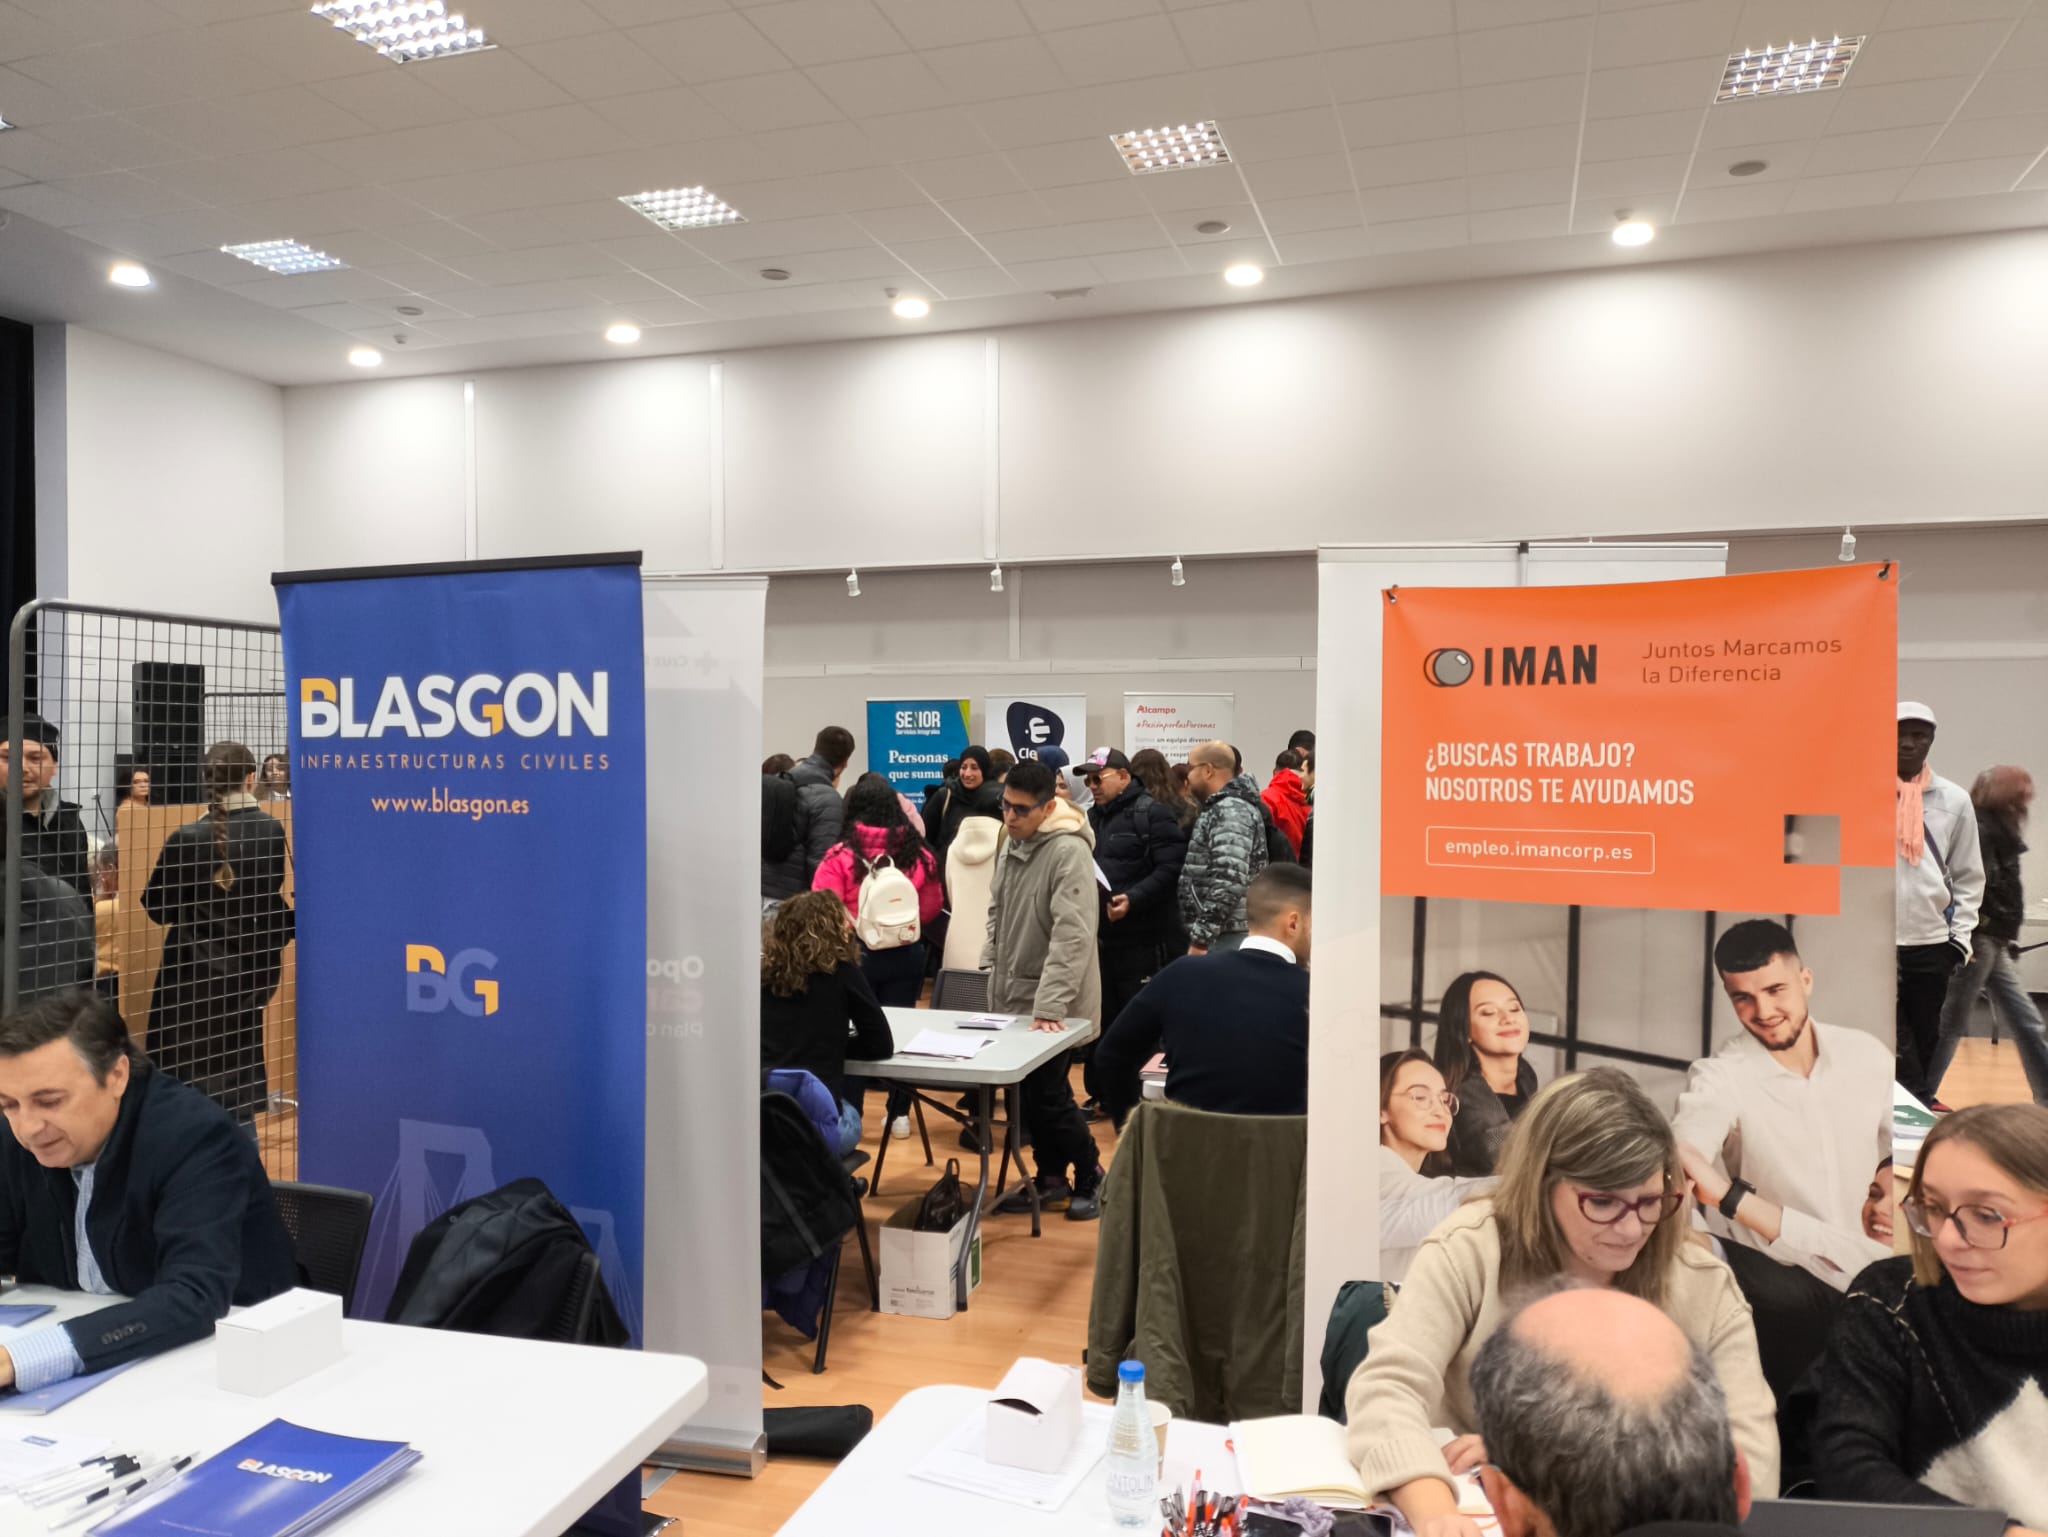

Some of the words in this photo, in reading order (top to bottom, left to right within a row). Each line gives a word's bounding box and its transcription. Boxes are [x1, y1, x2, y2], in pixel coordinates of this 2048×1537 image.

[1641, 642, 1716, 660] Juntos
[1723, 638, 1843, 657] Marcamos
[1483, 643, 1598, 687] IMAN
[1642, 666, 1661, 684] la
[1668, 664, 1782, 684] Diferencia
[300, 671, 609, 738] BLASGON
[1136, 704, 1177, 715] Alcampo
[300, 754, 505, 770] INFRAESTRUCTURAS
[520, 754, 610, 771] CIVILES
[888, 749, 949, 764] Personas
[1426, 742, 1518, 772] ¿BUSCAS
[1523, 742, 1636, 768] TRABAJO?
[888, 765, 910, 783] que
[1425, 776, 1534, 803] NOSOTROS
[1538, 778, 1564, 803] TE
[1570, 779, 1695, 805] AYUDAMOS
[371, 787, 531, 822] www.blasgon.es
[1444, 839, 1634, 863] empleo.imancorp.es
[236, 1458, 334, 1484] BLASGON
